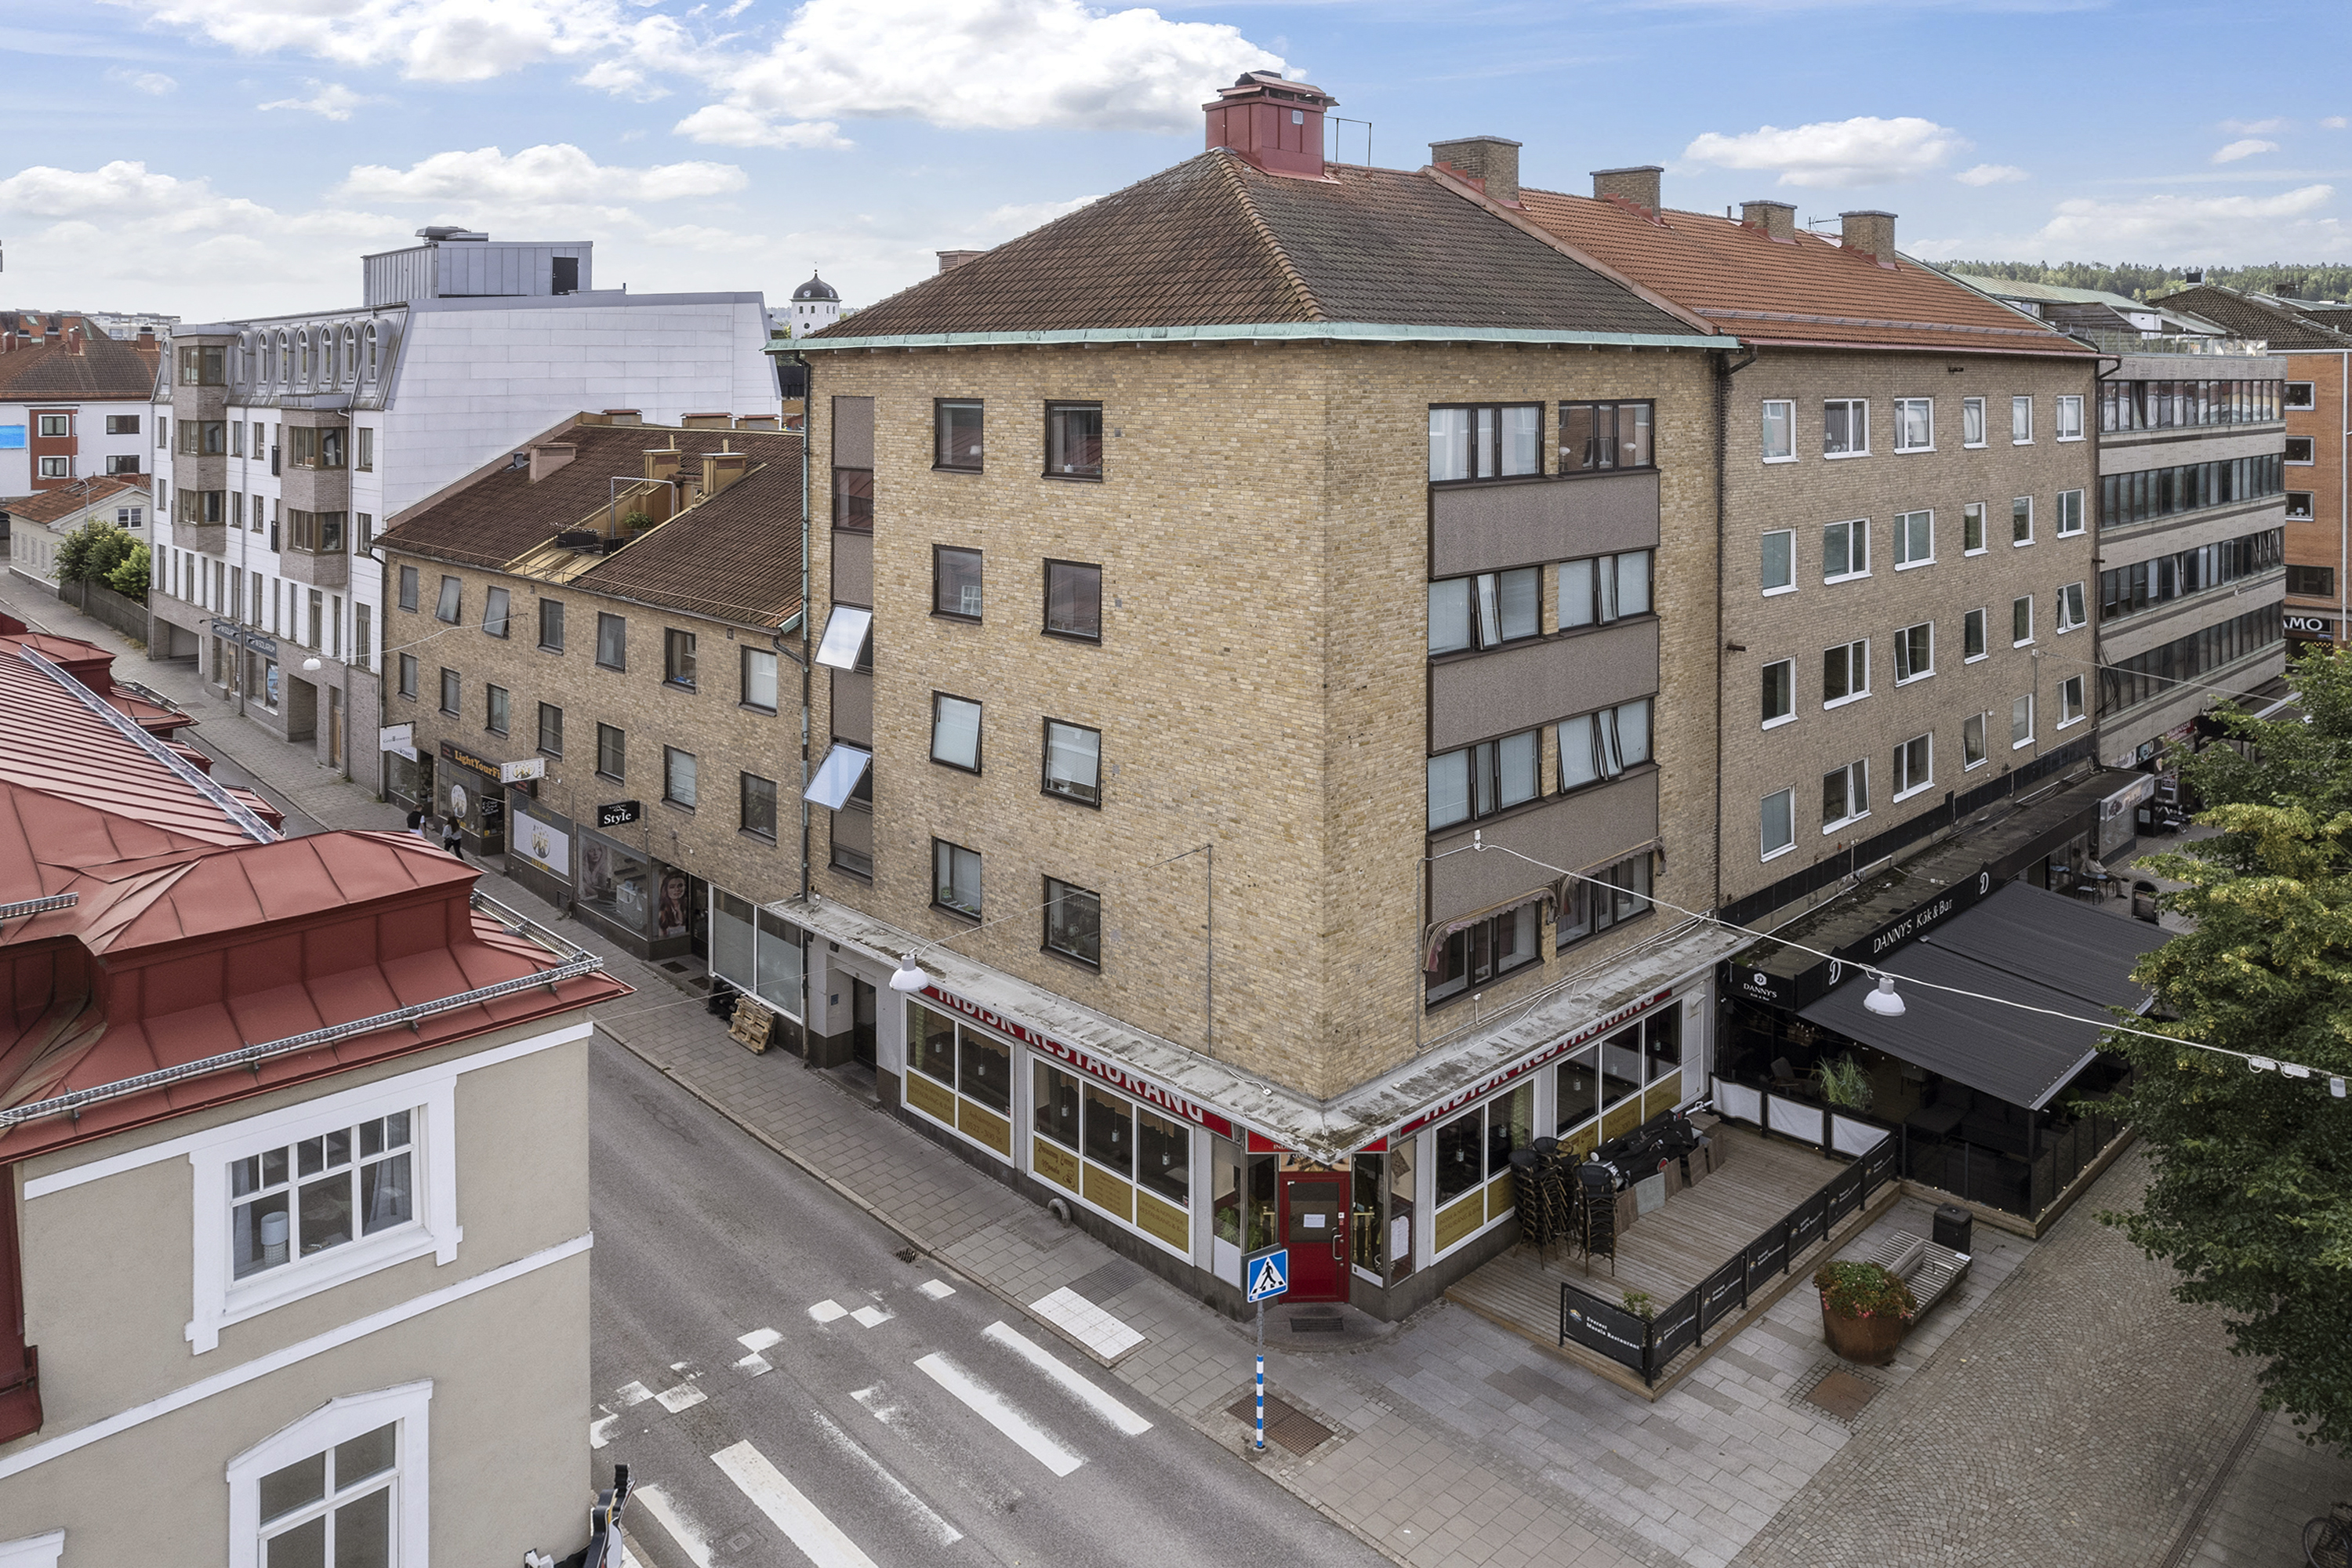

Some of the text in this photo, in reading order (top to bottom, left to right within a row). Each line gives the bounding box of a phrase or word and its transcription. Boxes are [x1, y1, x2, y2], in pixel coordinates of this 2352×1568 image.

[455, 750, 501, 779] LightYourFi
[604, 812, 632, 825] Style
[1874, 919, 1912, 954] DANNY'S
[1916, 909, 1932, 928] Kök
[1939, 899, 1953, 916] Bar
[1744, 982, 1777, 999] DANNY'S
[1587, 1316, 1608, 1330] Everest
[1587, 1323, 1640, 1350] Masala Restaurant
